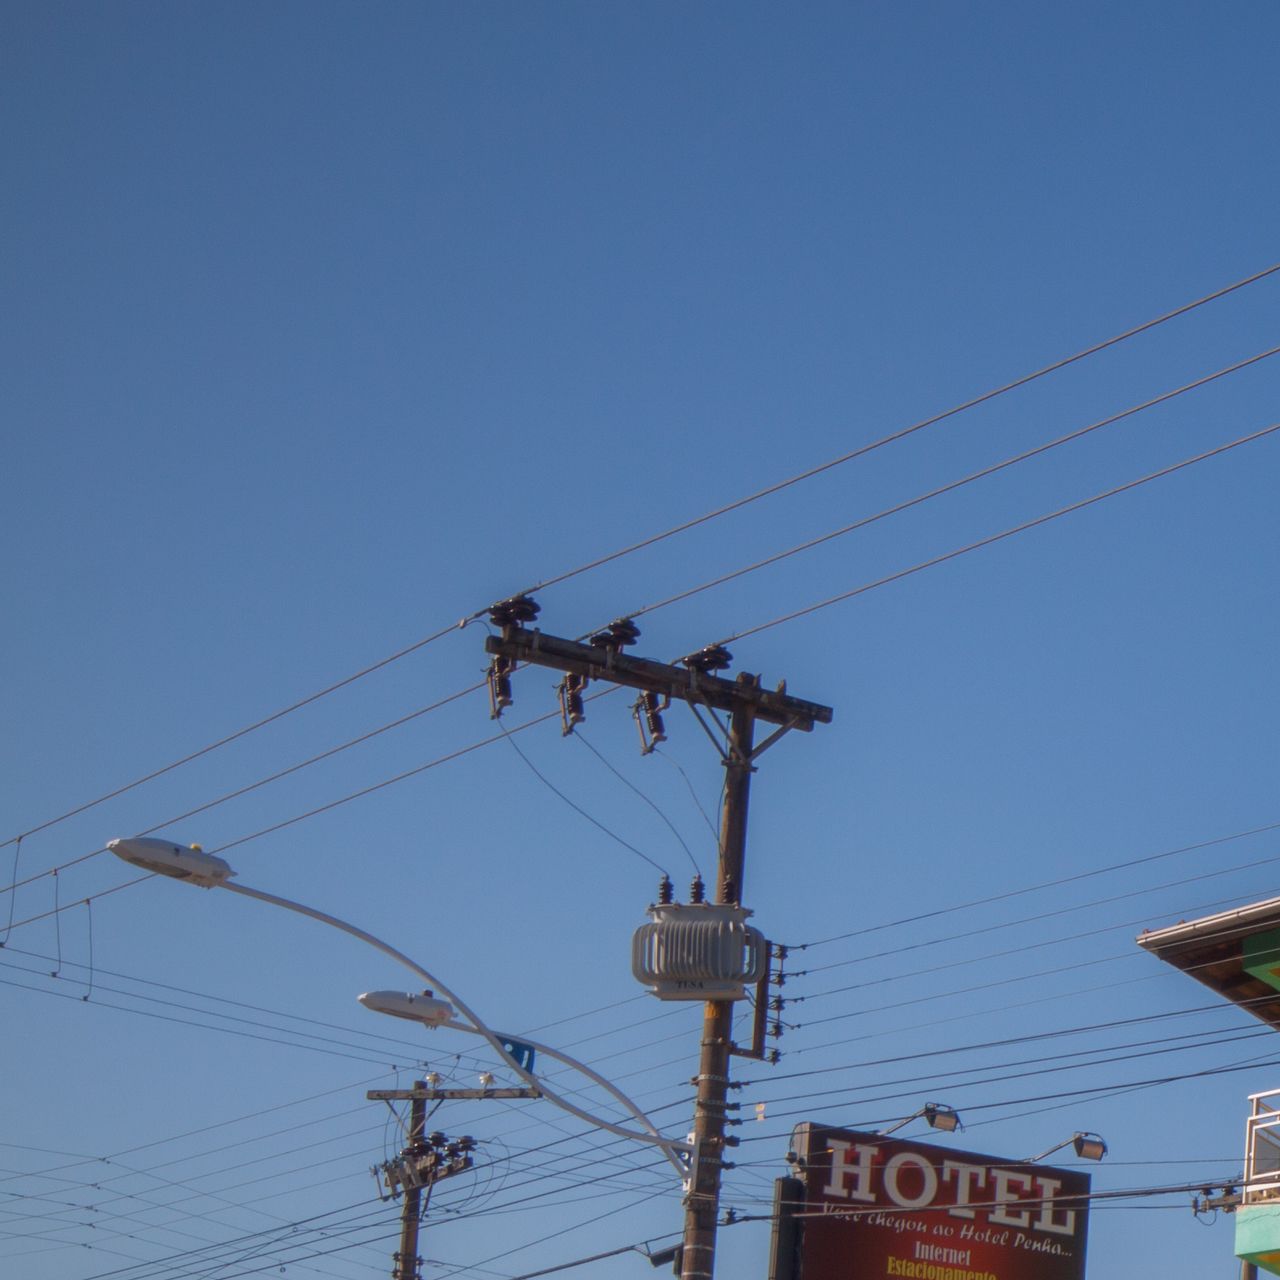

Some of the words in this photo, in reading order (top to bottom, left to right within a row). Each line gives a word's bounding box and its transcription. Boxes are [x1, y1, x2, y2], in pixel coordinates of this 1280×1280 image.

[823, 1138, 1076, 1236] HOTEL
[868, 1212, 927, 1232] chegou
[933, 1224, 954, 1236] ao
[960, 1224, 1009, 1246] Hotel
[1014, 1232, 1073, 1257] Penha...
[914, 1241, 971, 1266] Internet
